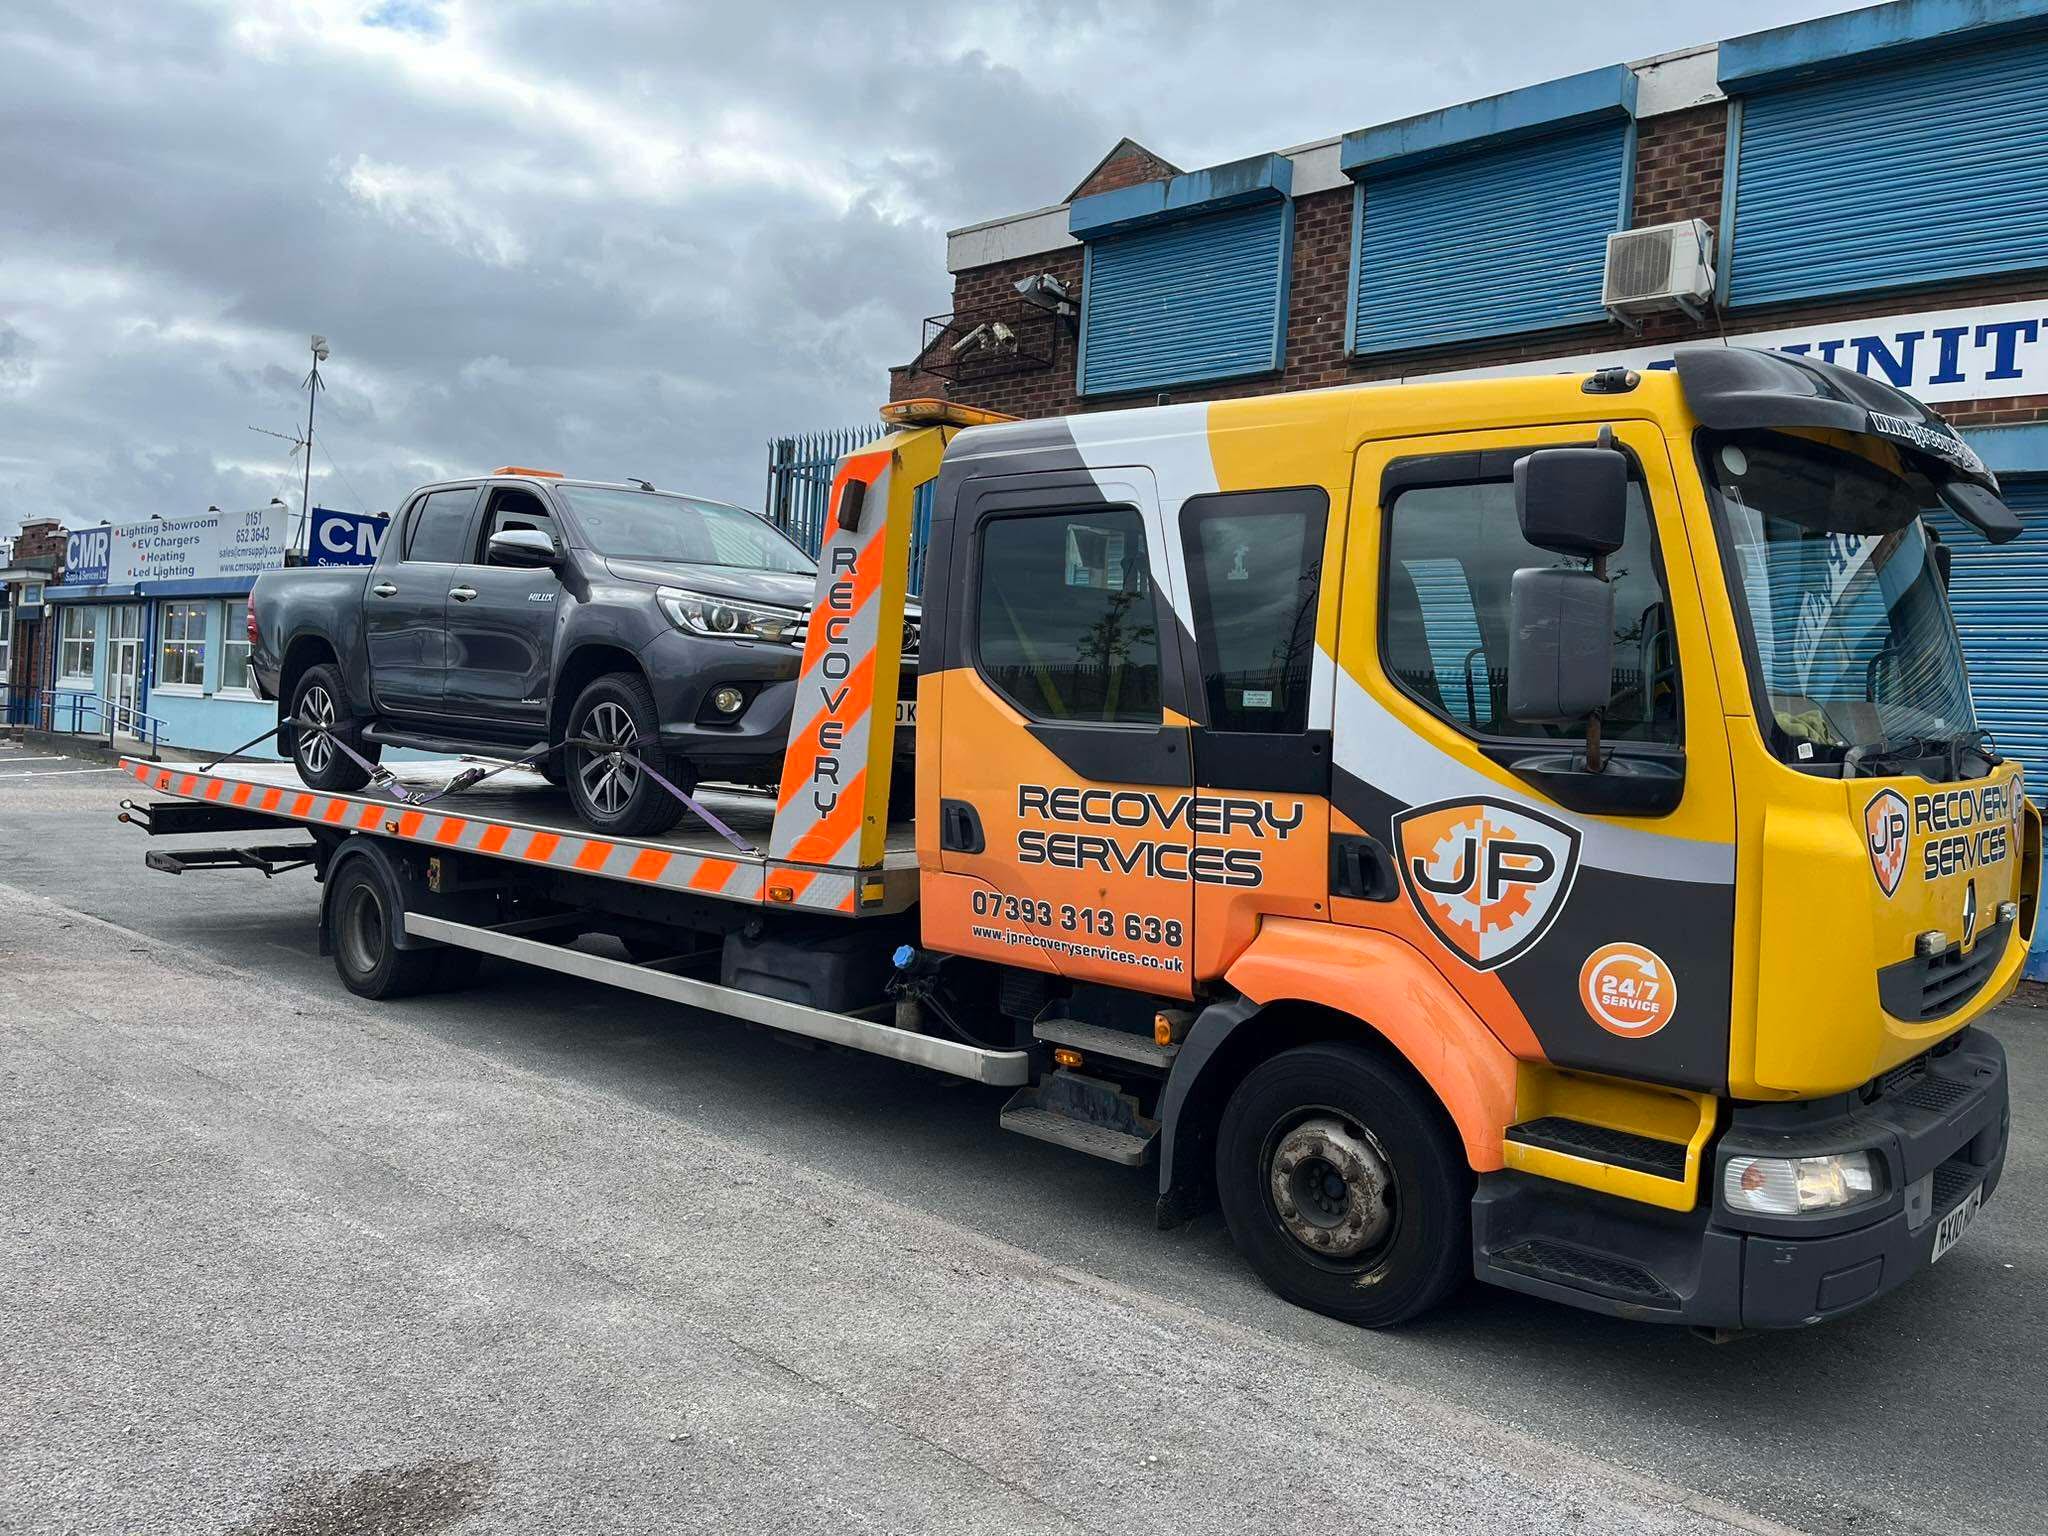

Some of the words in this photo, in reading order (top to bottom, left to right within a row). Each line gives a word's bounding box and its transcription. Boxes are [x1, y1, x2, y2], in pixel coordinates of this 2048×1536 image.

[121, 525, 159, 538] Lighting
[162, 519, 218, 532] Showroom
[236, 528, 250, 543] 652
[251, 527, 270, 542] 3643
[246, 512, 262, 526] 0151
[67, 532, 108, 570] CMR
[138, 539, 151, 549] EV
[154, 536, 200, 548] Chargers
[147, 551, 186, 562] Heating
[133, 566, 151, 577] Led
[153, 565, 195, 578] Lighting
[813, 546, 858, 820] RECOVERY
[1018, 784, 1303, 840] RECOVERY
[1914, 784, 2009, 836] RECOVERY
[1871, 813, 1906, 855] JP
[1924, 826, 2006, 881] SERVICES
[1017, 830, 1263, 888] SERVICES
[1412, 836, 1556, 901] JP
[972, 890, 1052, 927] 07393
[1060, 904, 1115, 937] 313
[1124, 912, 1184, 948] 638
[972, 925, 1184, 973] www.jprecoveryservices.co.uk
[1602, 974, 1660, 1001] 24/7
[1602, 994, 1661, 1013] SERVICE
